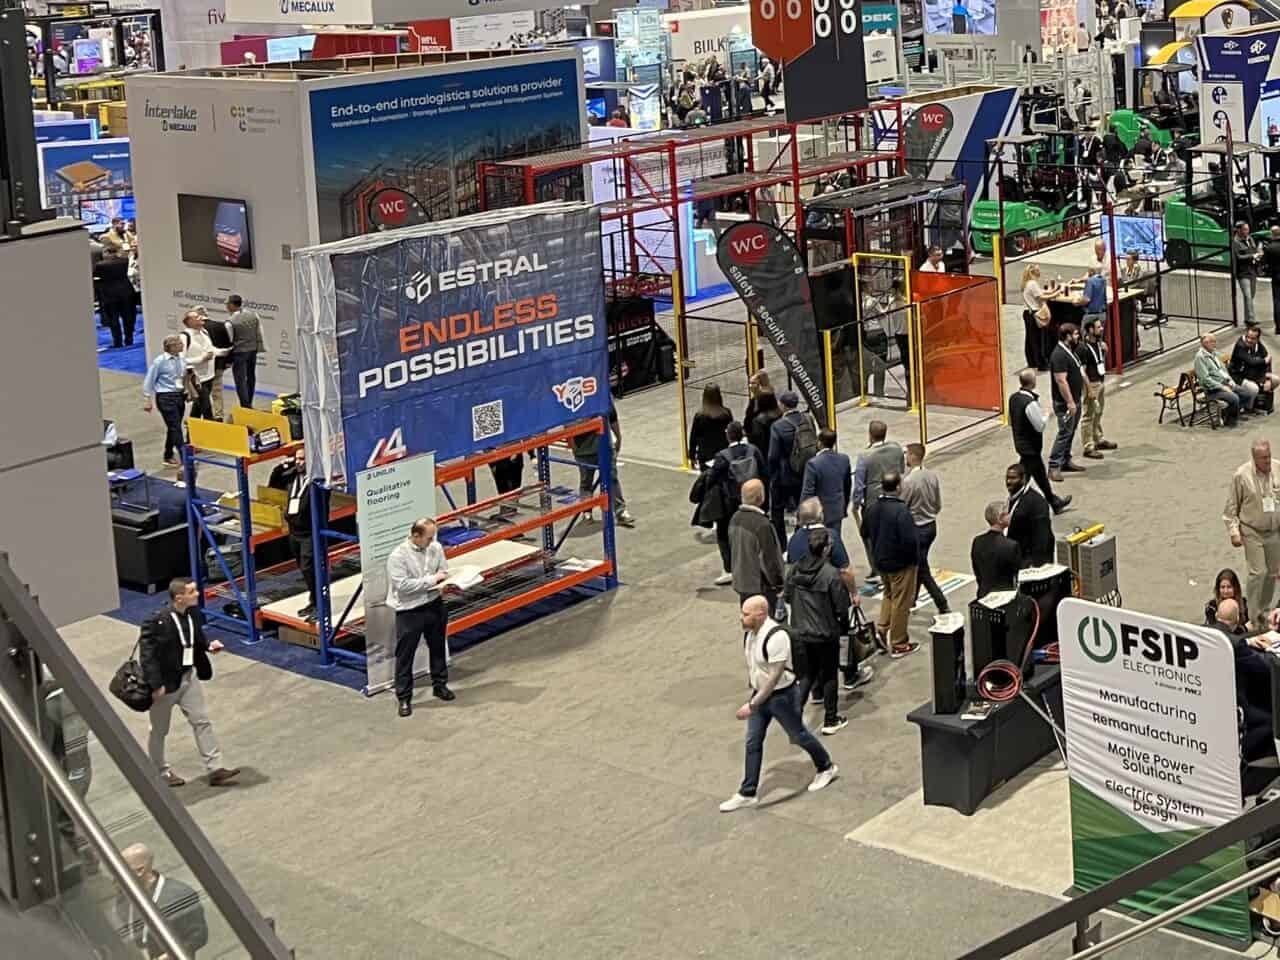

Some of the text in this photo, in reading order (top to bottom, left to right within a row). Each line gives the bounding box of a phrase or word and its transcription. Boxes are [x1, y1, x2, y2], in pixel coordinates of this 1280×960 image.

[291, 1, 335, 13] MECALUX
[694, 38, 724, 55] BULK
[145, 99, 197, 120] interlake
[330, 76, 563, 118] End-to-end intralogistics solutions provider
[923, 112, 945, 124] WC
[379, 200, 405, 215] WC
[731, 234, 766, 255] WC
[439, 253, 548, 292] ESTRAL
[729, 264, 757, 299] safety
[399, 293, 559, 353] ENDLESS
[757, 304, 788, 346] security
[359, 314, 595, 399] POSSIBILITIES
[787, 352, 825, 410] separation
[366, 479, 411, 497] Qualitative
[1120, 623, 1199, 669] FSIP
[1122, 659, 1202, 687] ELECTRONICS
[1099, 689, 1197, 726] Manufacturing
[1092, 712, 1208, 754] Remanufacturing
[1107, 742, 1195, 776] Motive Power
[1122, 759, 1183, 785] Solutions
[1105, 778, 1205, 817] Electric System
[1132, 798, 1178, 822] Design
